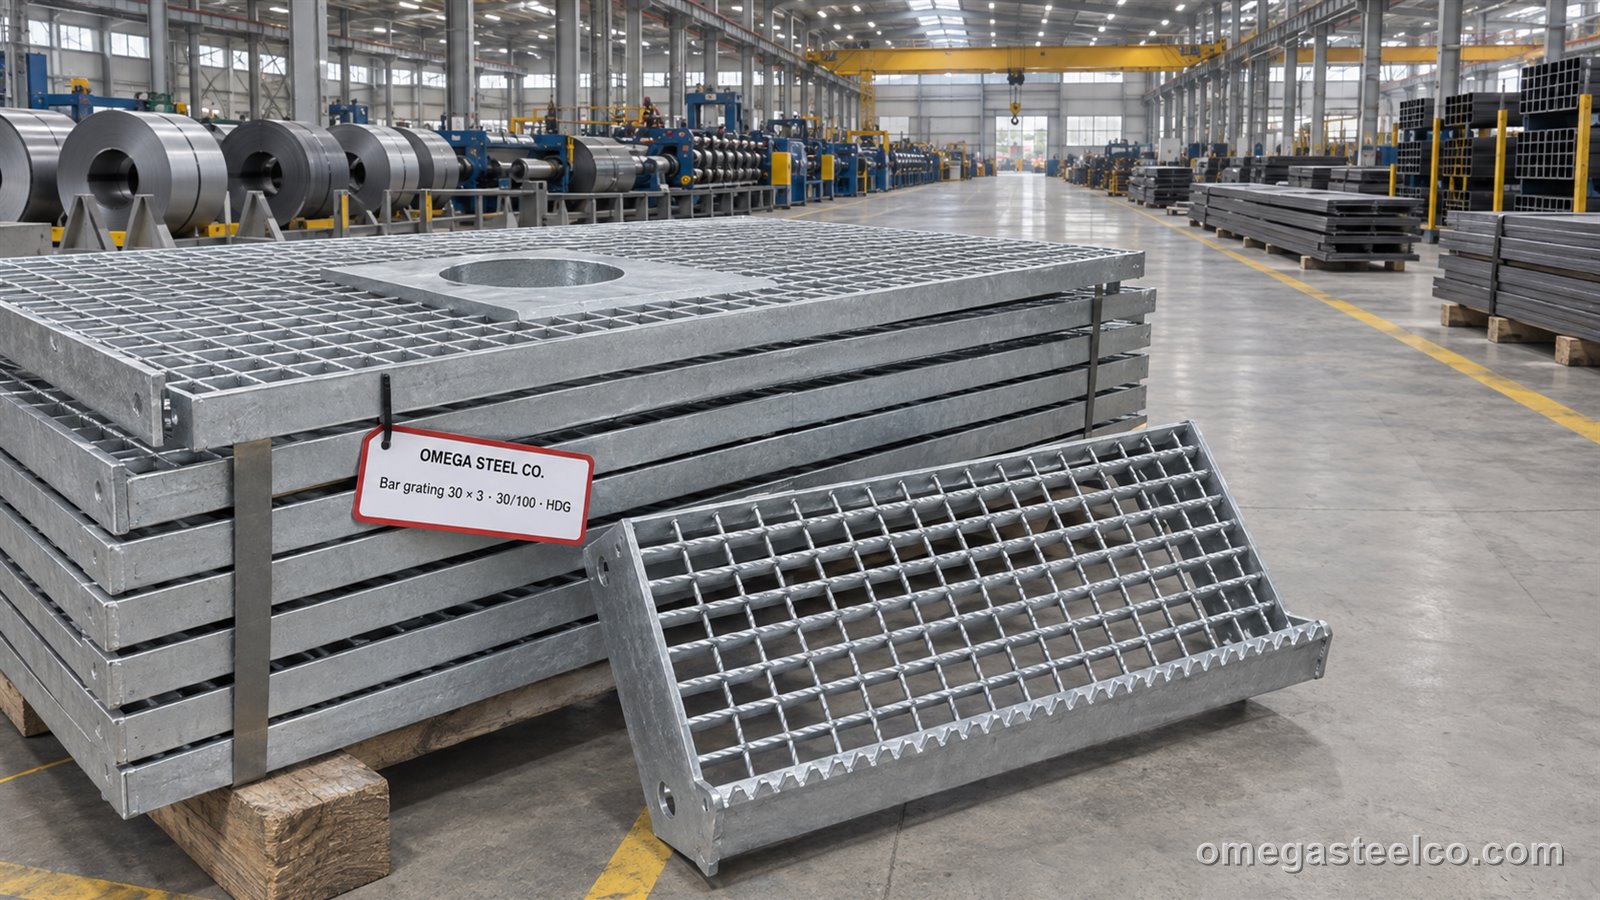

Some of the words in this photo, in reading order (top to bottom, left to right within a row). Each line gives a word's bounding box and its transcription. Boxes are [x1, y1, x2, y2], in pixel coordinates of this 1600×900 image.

[420, 448, 472, 468] OMEGA
[476, 456, 518, 475] STEEL
[522, 464, 545, 479] CO.
[379, 476, 401, 491] Bar
[403, 482, 445, 500] grating
[447, 486, 463, 499] 30
[476, 490, 484, 502] 3
[496, 492, 536, 508] 30/100
[546, 499, 571, 513] HDG
